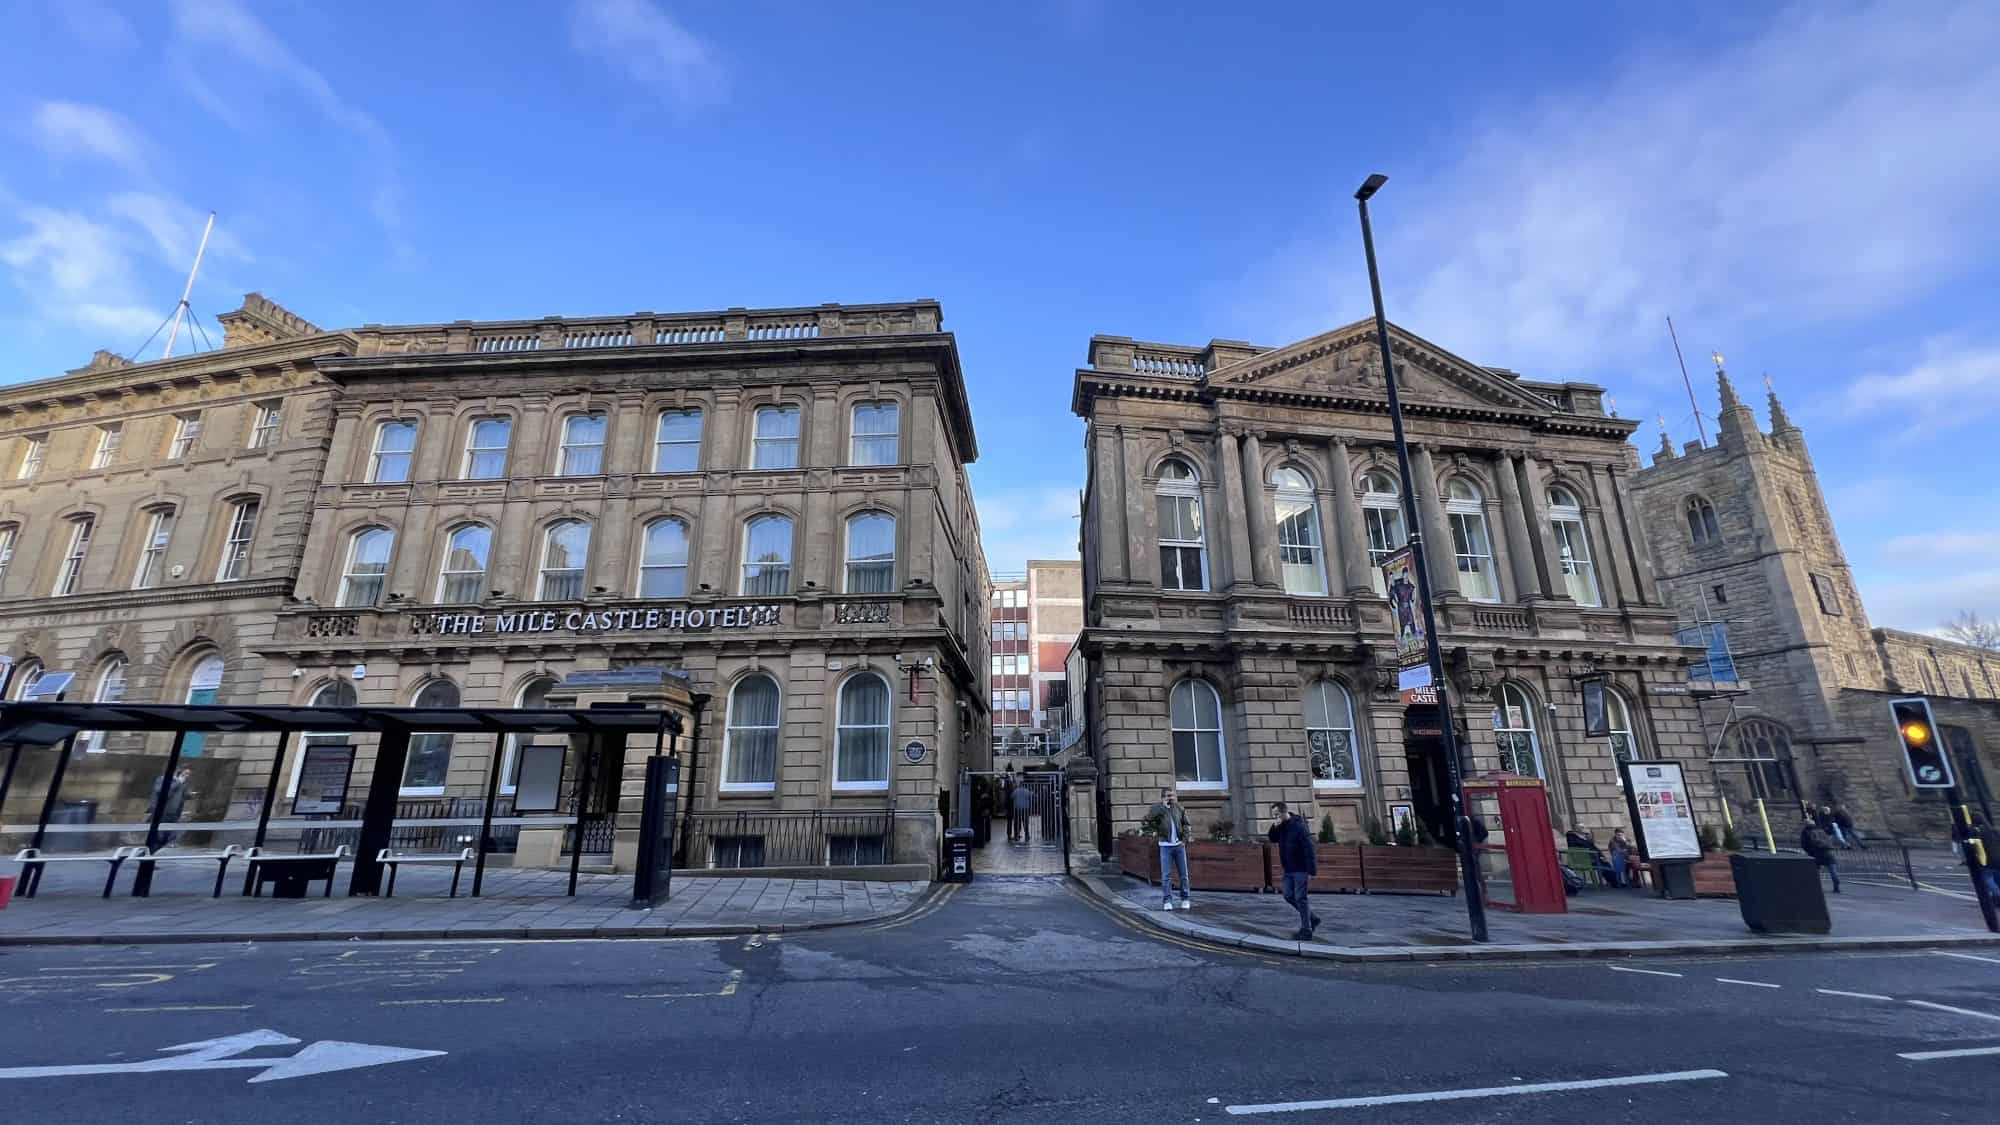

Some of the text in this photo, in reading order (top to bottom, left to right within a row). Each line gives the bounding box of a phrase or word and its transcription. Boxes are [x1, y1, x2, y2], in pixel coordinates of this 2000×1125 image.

[438, 608, 750, 634] THE MILE CASTLE HOTEL
[1415, 686, 1437, 695] MILE
[1410, 694, 1439, 704] CASTL
